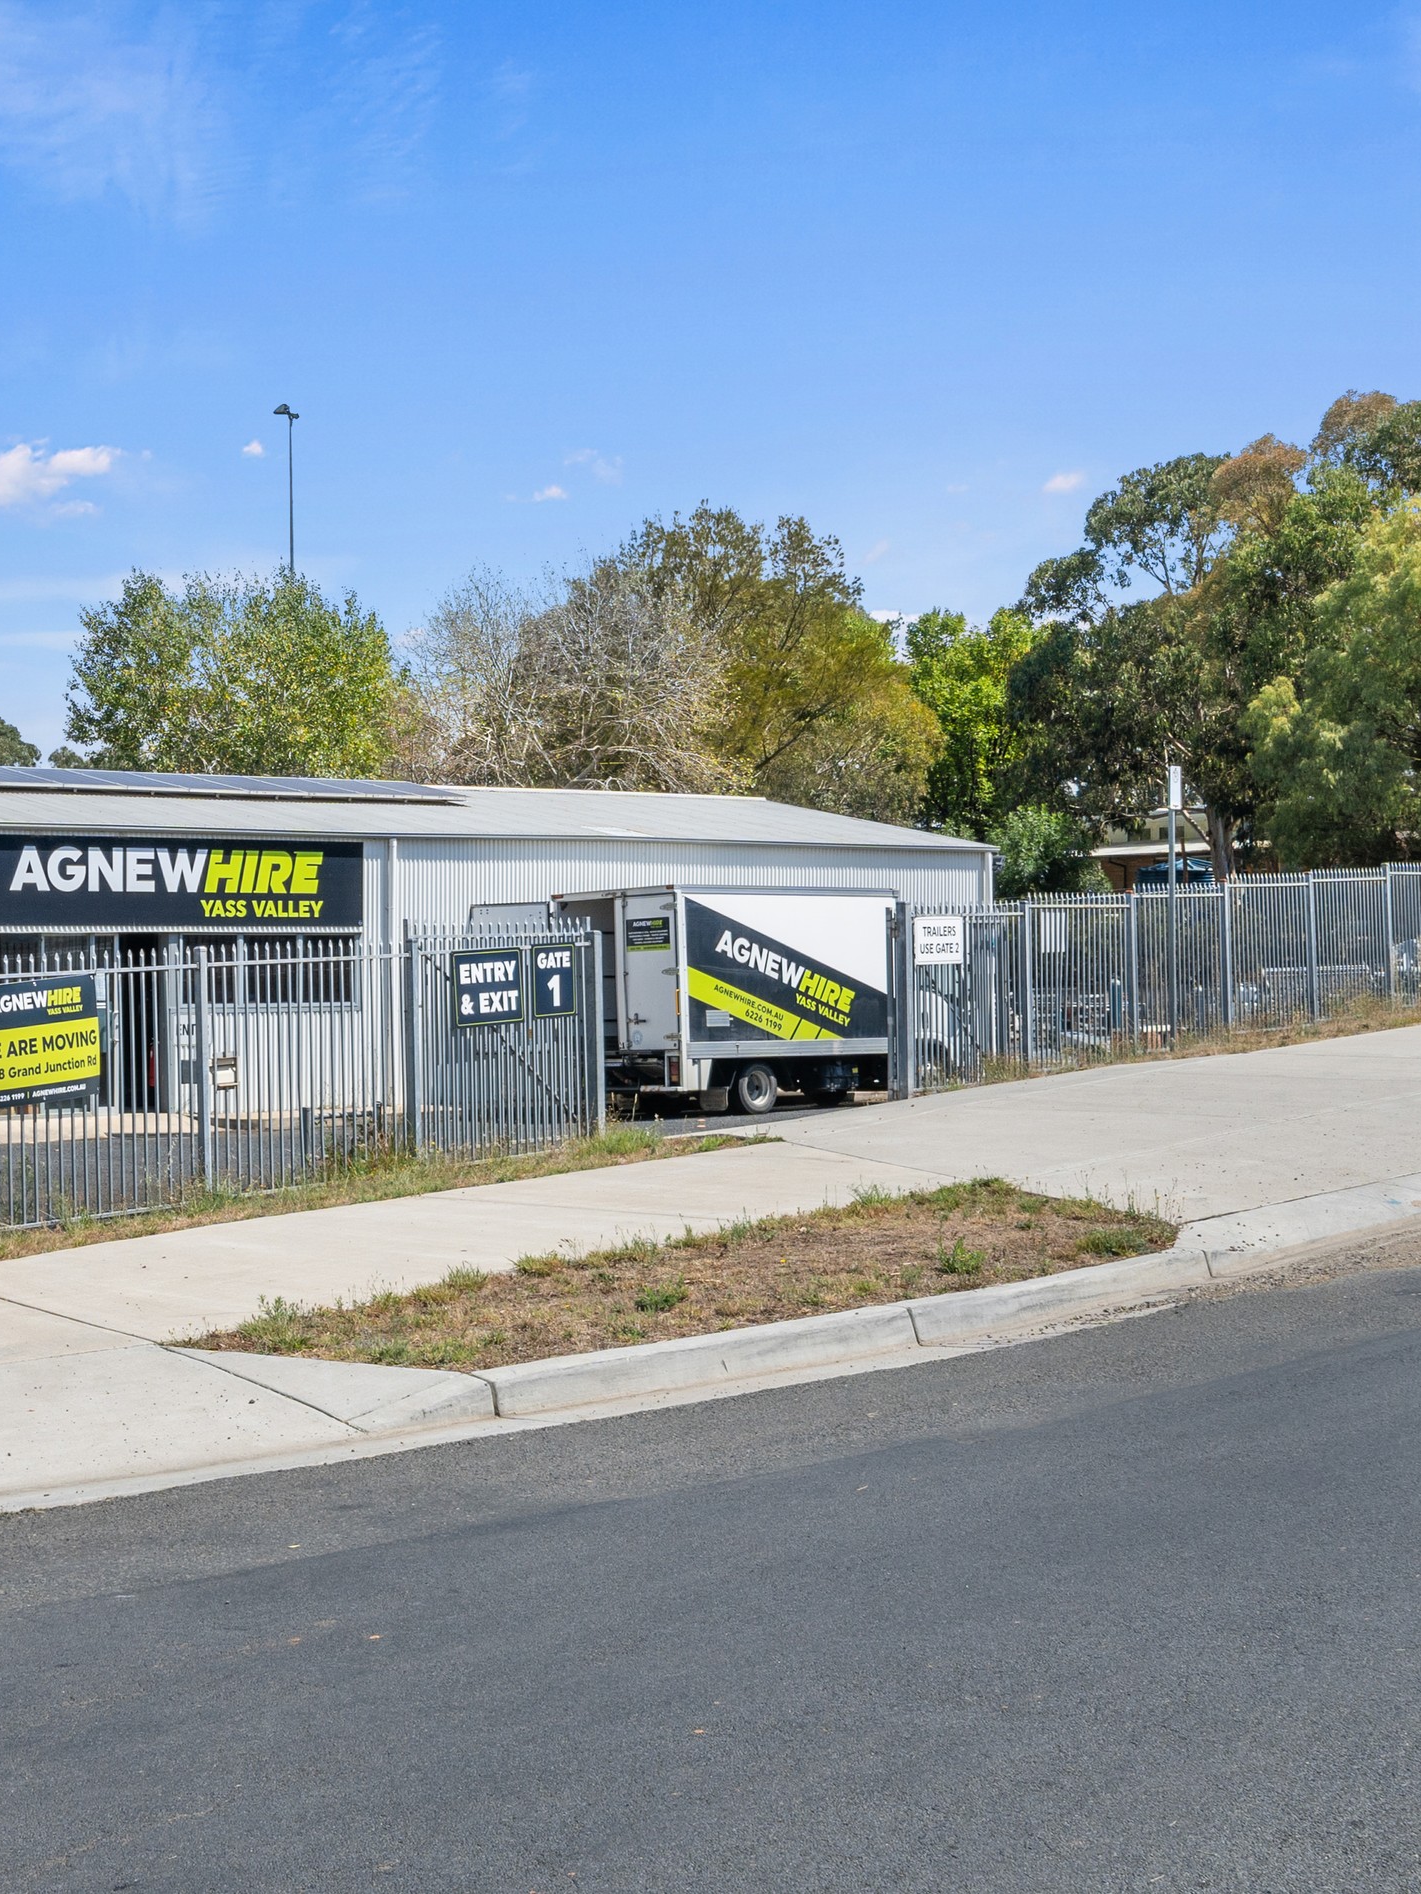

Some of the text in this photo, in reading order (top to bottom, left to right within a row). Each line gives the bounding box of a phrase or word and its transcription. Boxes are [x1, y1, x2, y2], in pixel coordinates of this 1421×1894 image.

[9, 845, 324, 894] AGNEWHIRE
[200, 899, 324, 918] YASS VALLEY
[922, 925, 957, 937] TRAILERS
[537, 951, 571, 969] GATE
[920, 942, 960, 954] USE GATE 2
[459, 960, 516, 985] ENTRY
[715, 929, 856, 1014] AGNEWHIRE
[460, 990, 519, 1015] & EXIT
[546, 974, 561, 1007] 1
[713, 984, 784, 1021] AGNEWHIRE.COM.AU
[47, 1004, 83, 1015] YASS VALLEY
[744, 1009, 783, 1032] 6226 1199
[795, 992, 851, 1027] YASS VALLEY
[7, 1038, 38, 1058] ARE
[42, 1029, 97, 1053] MOVING
[8, 1063, 41, 1079] Grand
[44, 1057, 85, 1074] Junction
[87, 1054, 97, 1066] Rd
[11, 1092, 25, 1101] 1199
[32, 1083, 87, 1098] AGNEWHIRE.COM.AU
